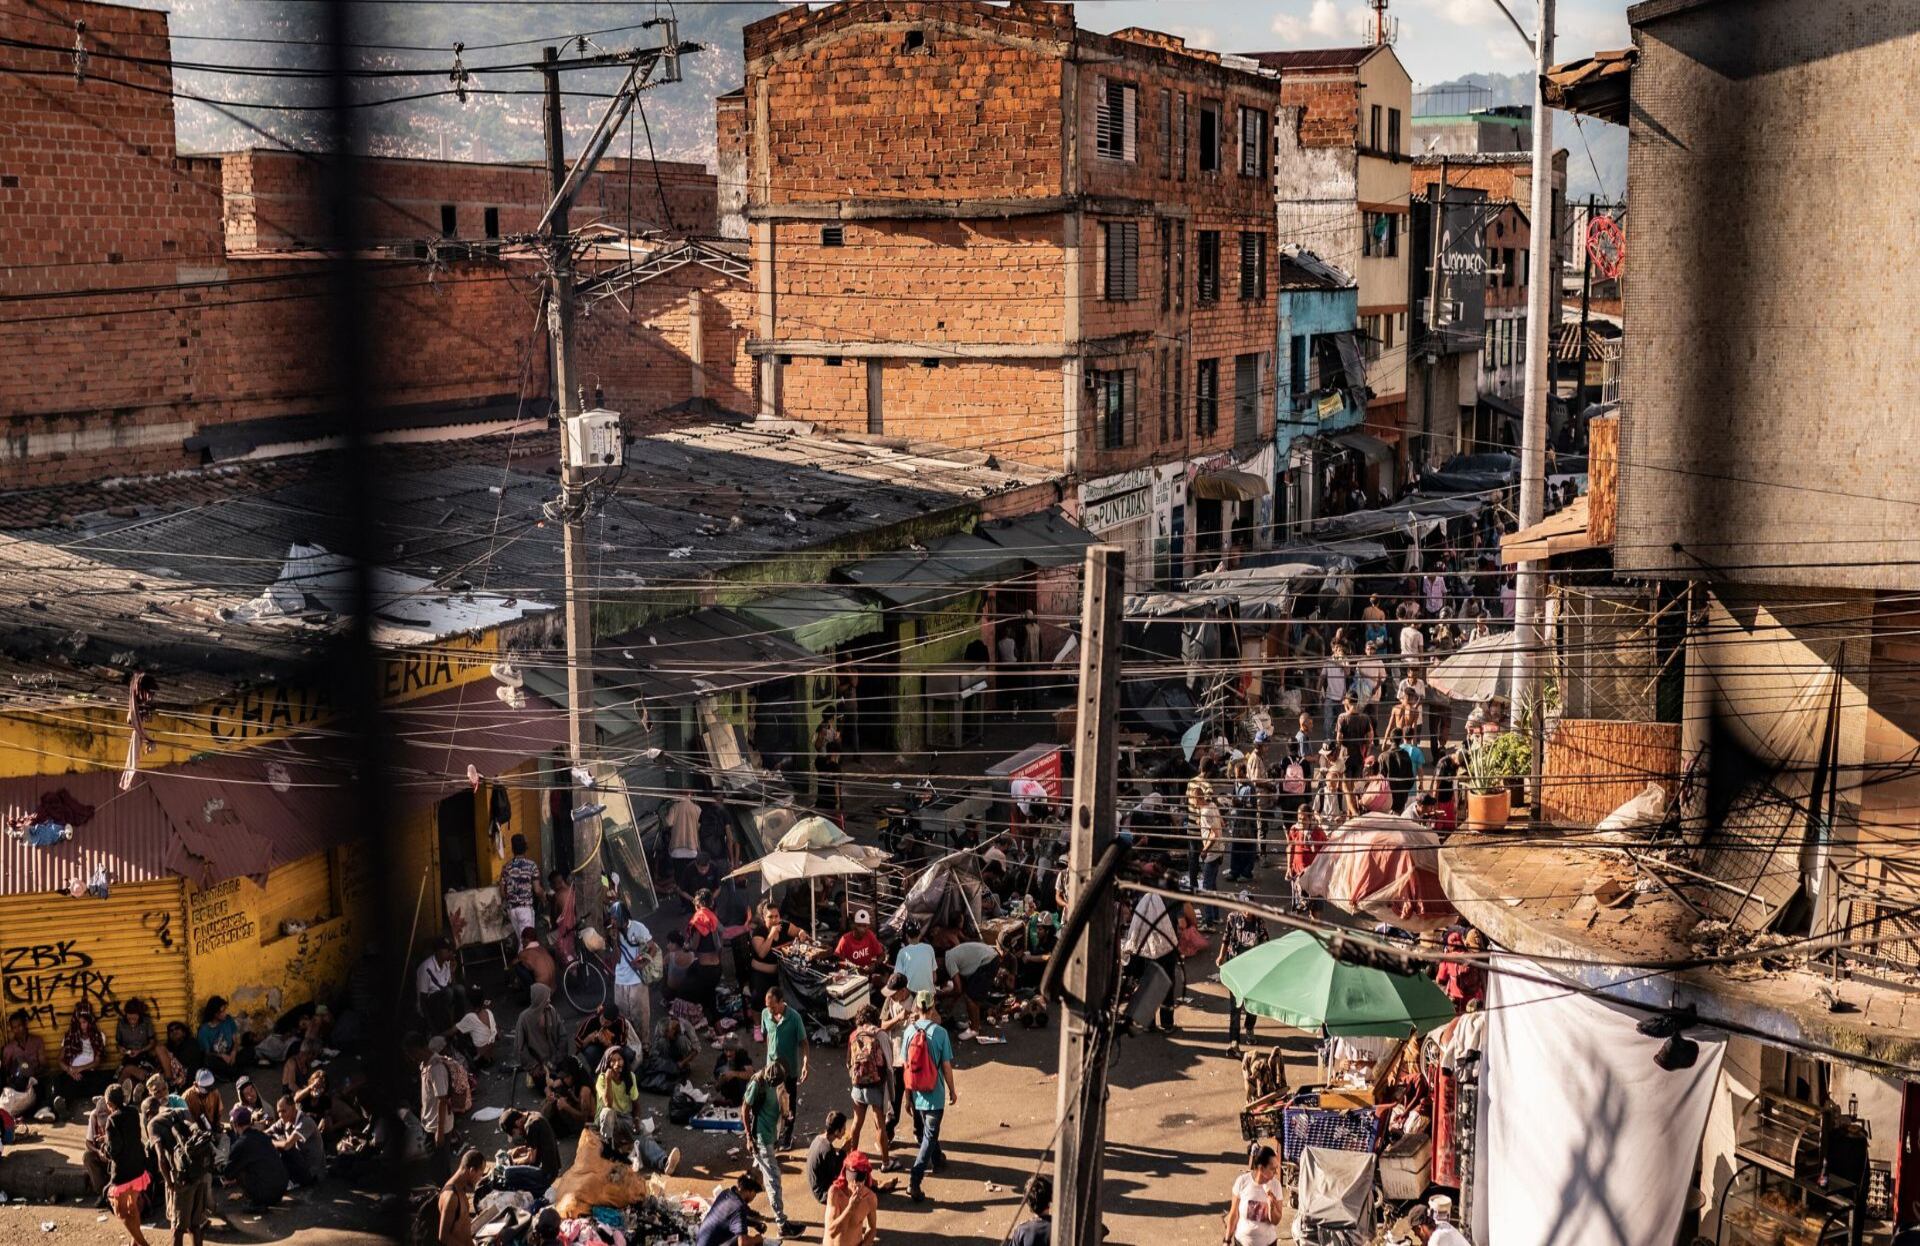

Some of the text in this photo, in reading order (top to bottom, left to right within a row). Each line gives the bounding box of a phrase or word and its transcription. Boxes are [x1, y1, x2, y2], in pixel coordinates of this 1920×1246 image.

[1099, 490, 1146, 528] PUNTADAS
[2, 940, 94, 974] ZBK
[852, 947, 869, 960] ONE
